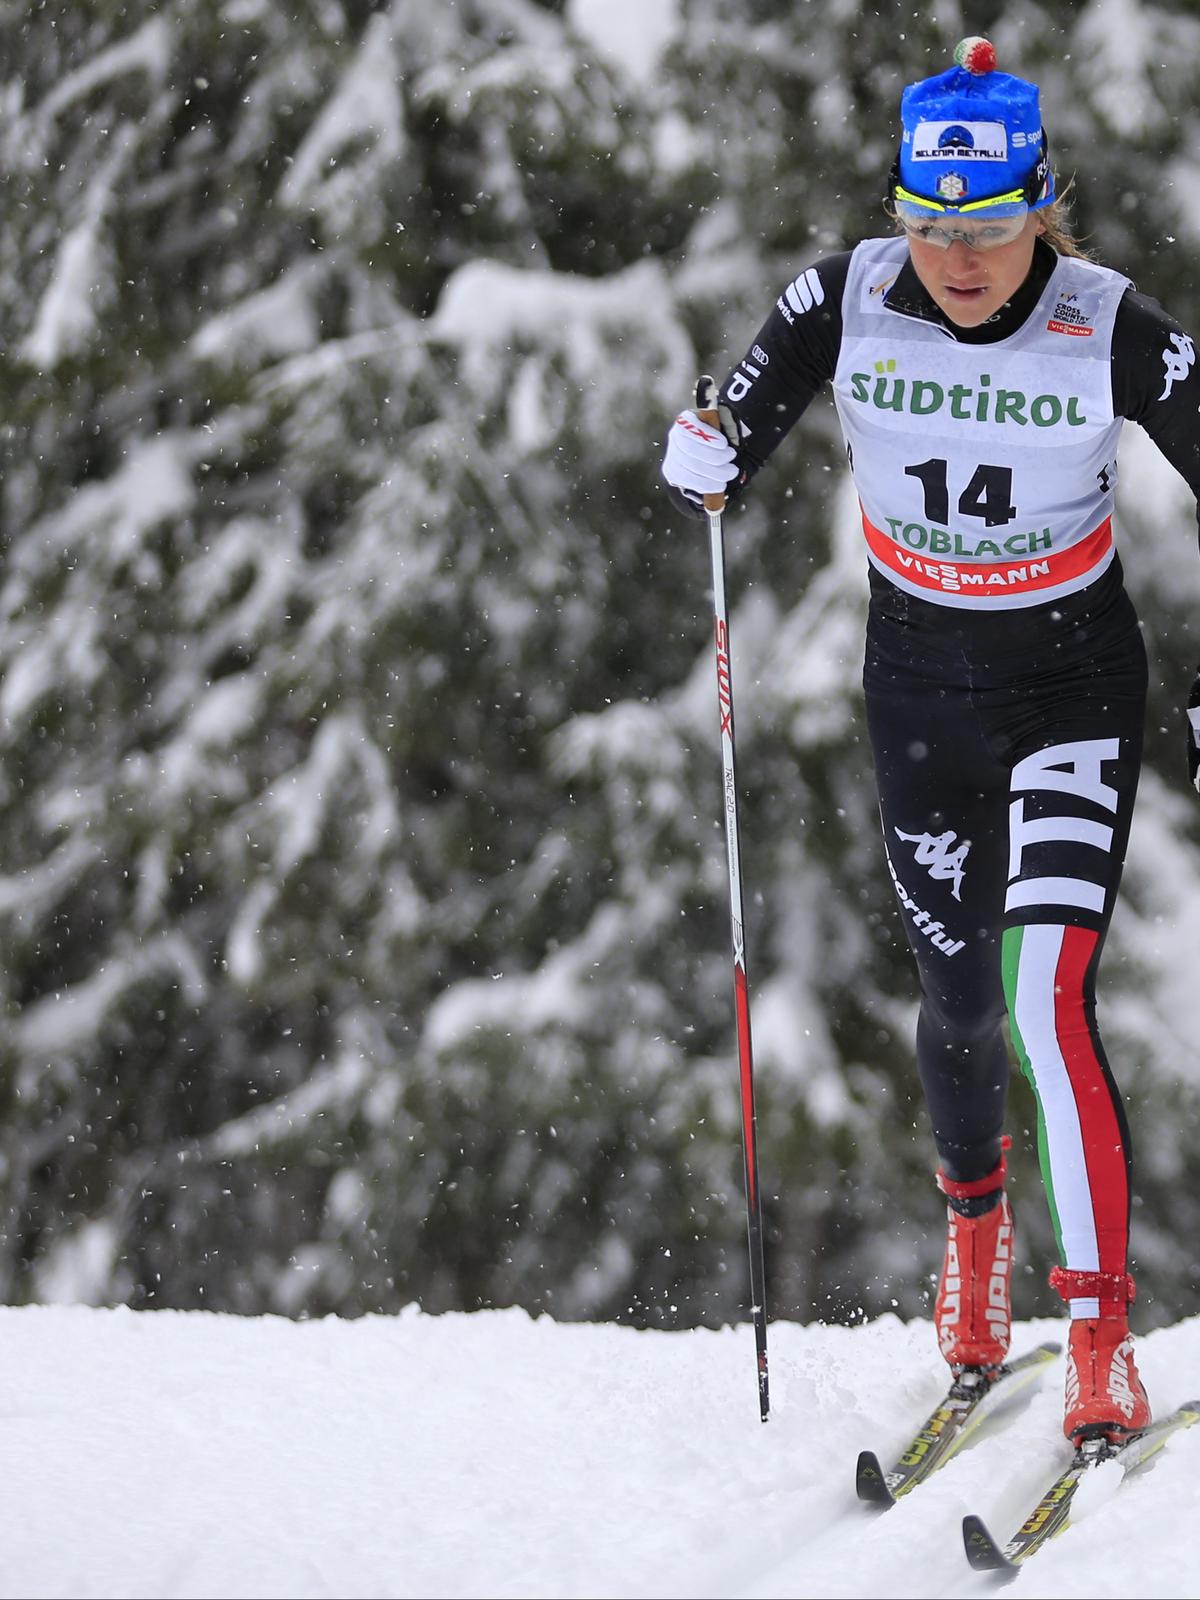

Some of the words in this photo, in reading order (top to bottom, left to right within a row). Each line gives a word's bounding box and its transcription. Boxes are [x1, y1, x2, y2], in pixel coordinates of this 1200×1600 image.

[1054, 308, 1090, 322] COUNTRY
[1056, 302, 1081, 315] CROSS
[904, 457, 1018, 528] 14
[883, 516, 1054, 557] TOBLACH
[894, 550, 1051, 592] VIESSMANN
[715, 614, 733, 740] SWIX
[1004, 737, 1120, 914] ITA
